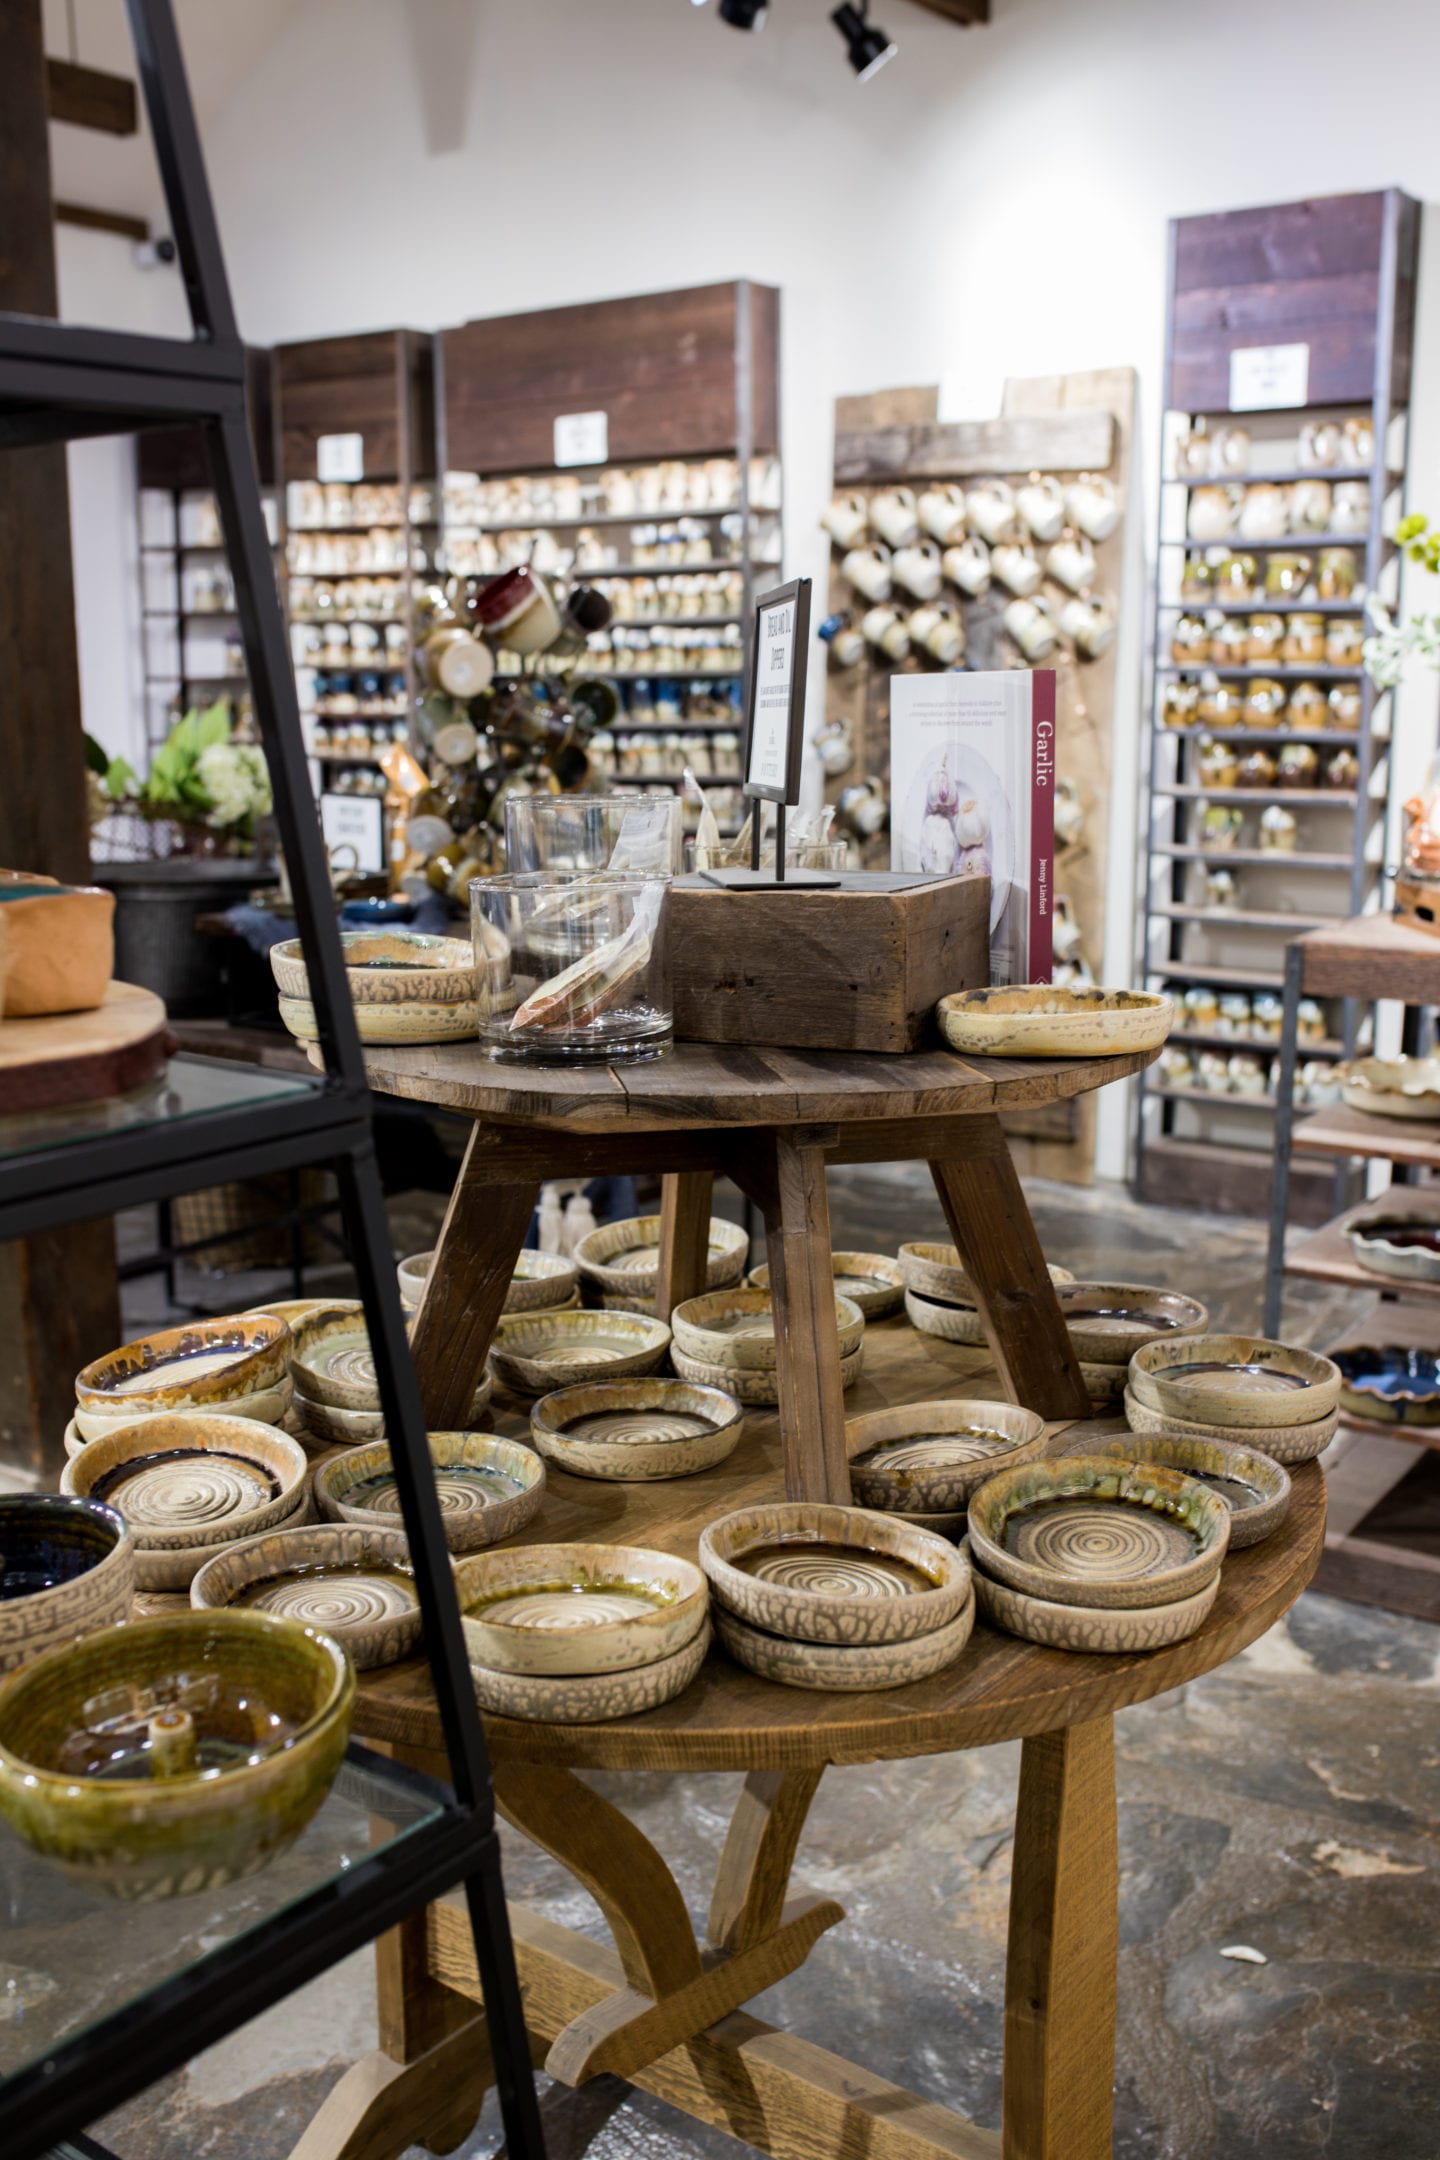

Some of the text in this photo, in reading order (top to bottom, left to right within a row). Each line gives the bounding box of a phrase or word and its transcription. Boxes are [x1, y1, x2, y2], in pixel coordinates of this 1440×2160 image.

[1036, 720, 1053, 787] Garlic
[1038, 858, 1048, 915] Jenny Linford
